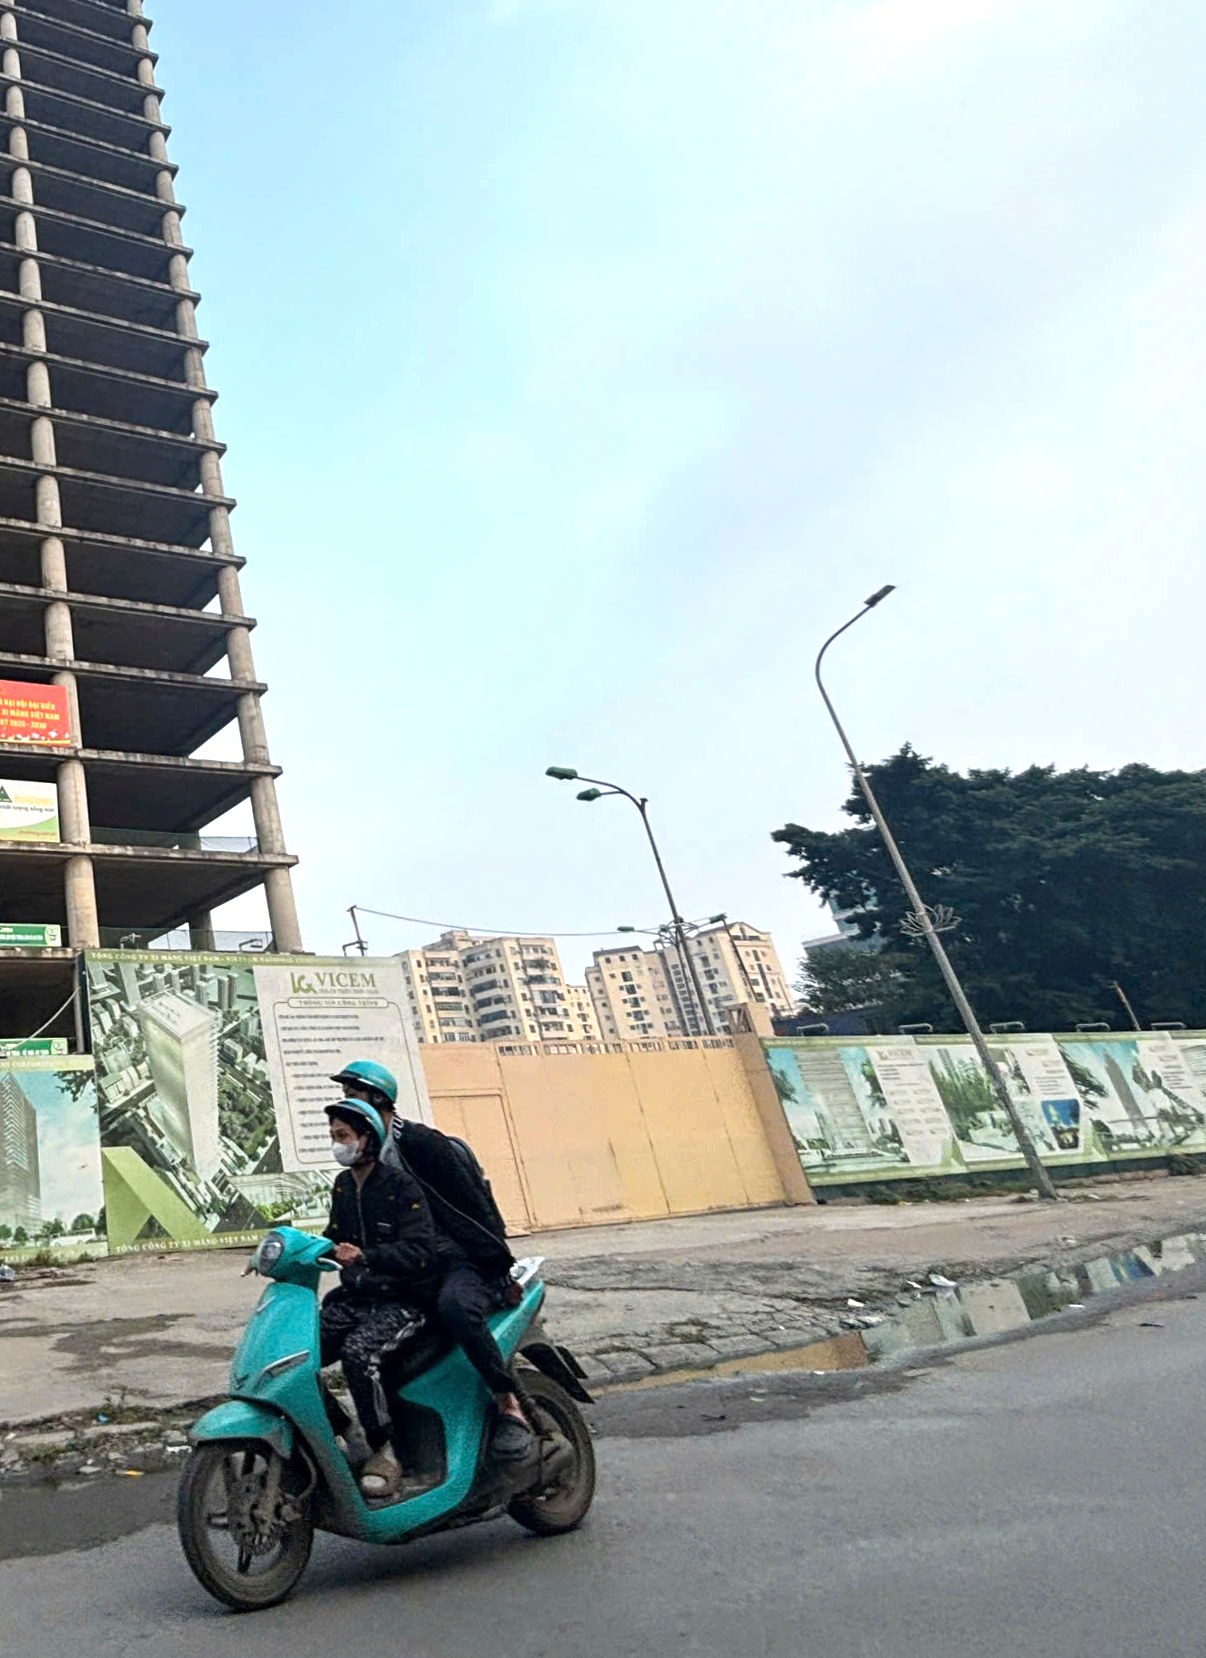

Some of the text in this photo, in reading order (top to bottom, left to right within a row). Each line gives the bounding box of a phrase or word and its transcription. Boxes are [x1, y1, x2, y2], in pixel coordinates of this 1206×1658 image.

[45, 711, 60, 720] NAM
[92, 952, 112, 960] TỔNG
[115, 952, 136, 961] CÔNG
[184, 955, 201, 963] VIỆT
[315, 972, 376, 988] VICEM
[116, 1242, 140, 1253] TỔNG
[142, 1240, 166, 1251] CÔNG
[168, 1240, 180, 1248] TY
[182, 1239, 192, 1247] XI
[219, 1236, 238, 1245] VIỆT
[240, 1234, 258, 1242] NAM
